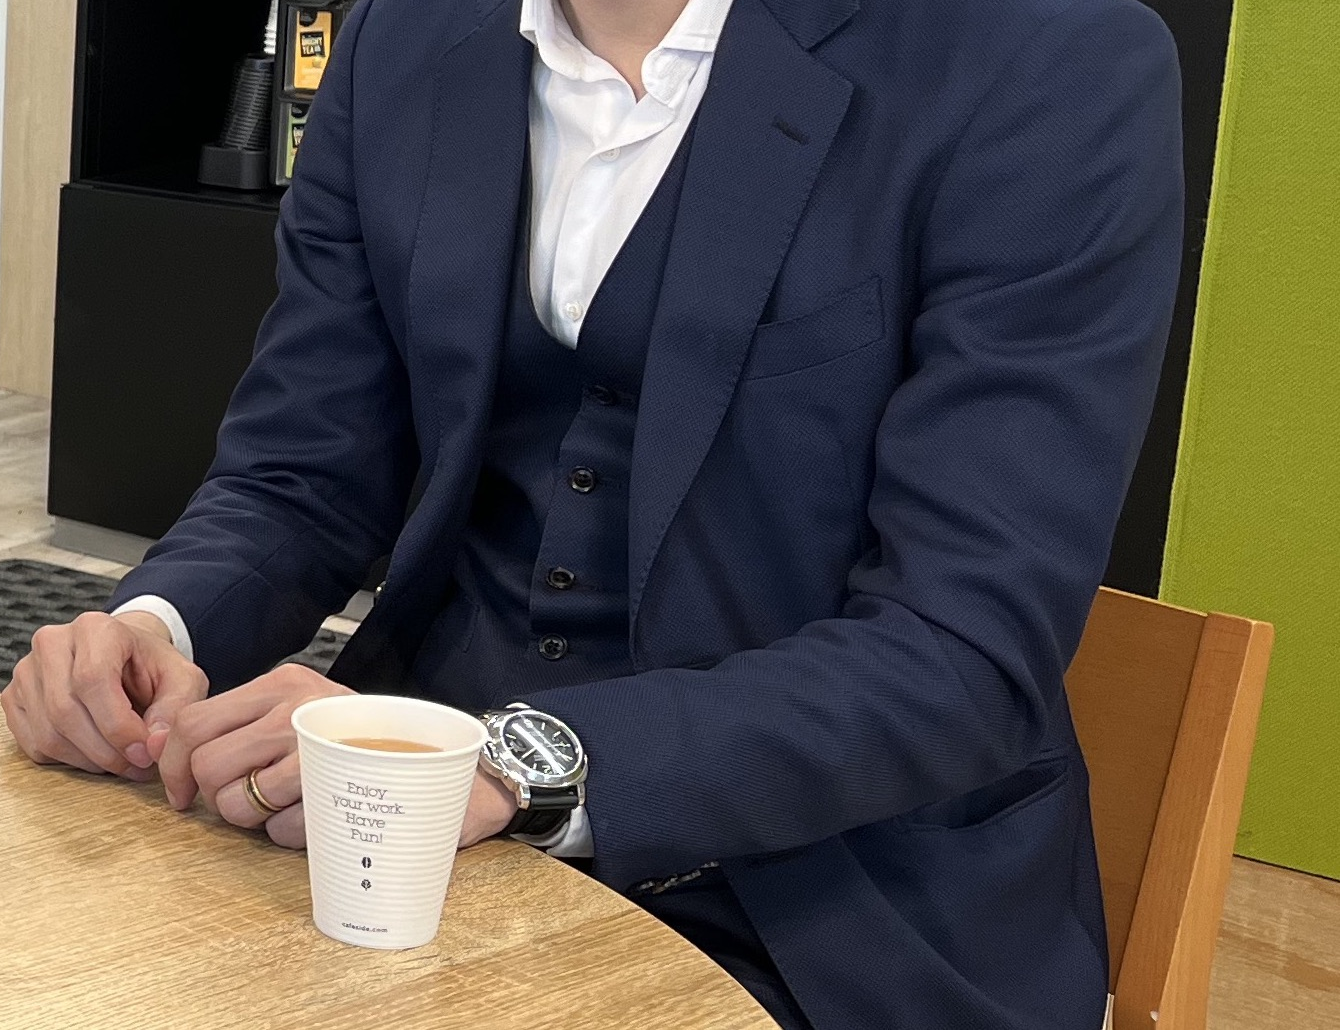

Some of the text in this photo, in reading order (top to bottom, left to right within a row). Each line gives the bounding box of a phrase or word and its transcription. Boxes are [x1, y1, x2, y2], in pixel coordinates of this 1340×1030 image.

[346, 781, 388, 800] Enjoy
[332, 794, 363, 810] your
[345, 811, 386, 829] Have
[350, 828, 383, 844] Fun!
